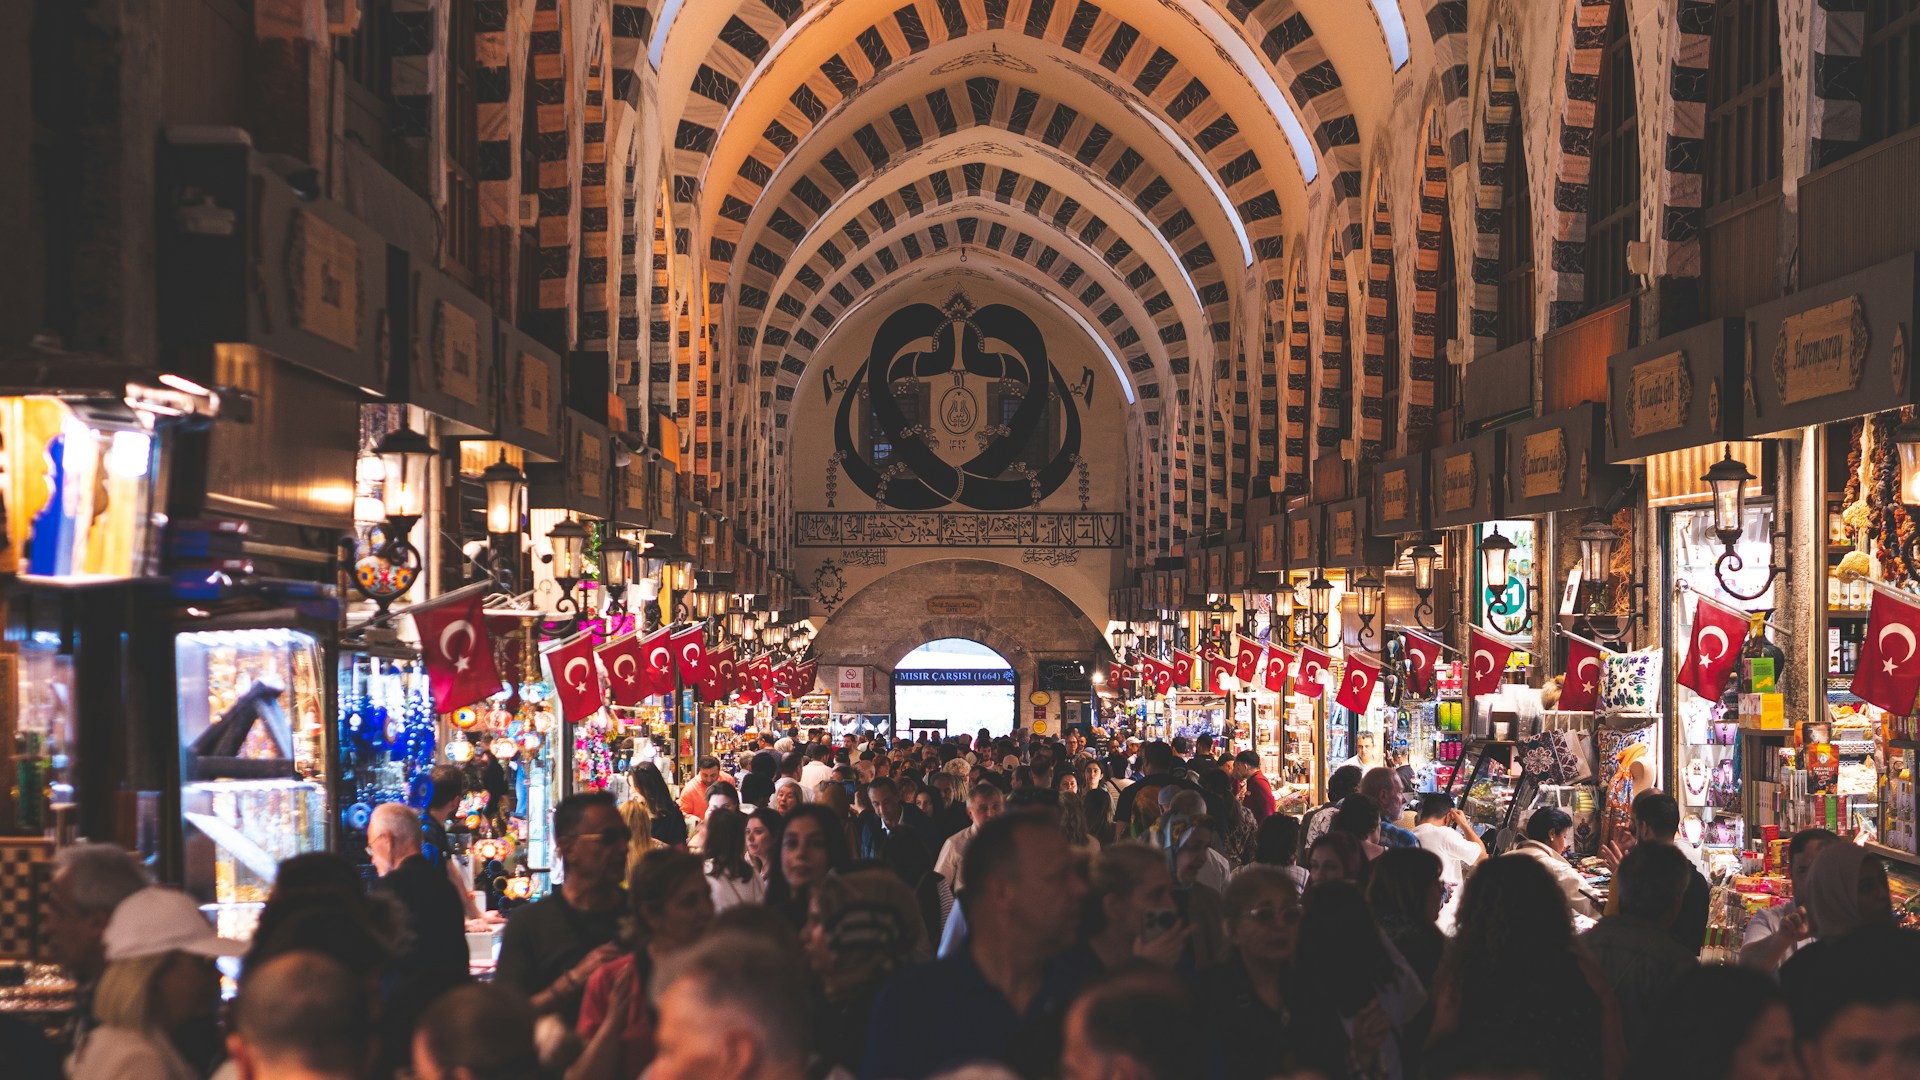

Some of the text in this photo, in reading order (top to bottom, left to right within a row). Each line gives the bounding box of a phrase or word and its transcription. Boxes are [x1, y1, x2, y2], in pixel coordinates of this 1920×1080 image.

[1793, 332, 1844, 372] Haremsaray
[1892, 344, 1902, 376] 37
[900, 672, 1001, 682] MISIR ÇARŞISI (1664)
